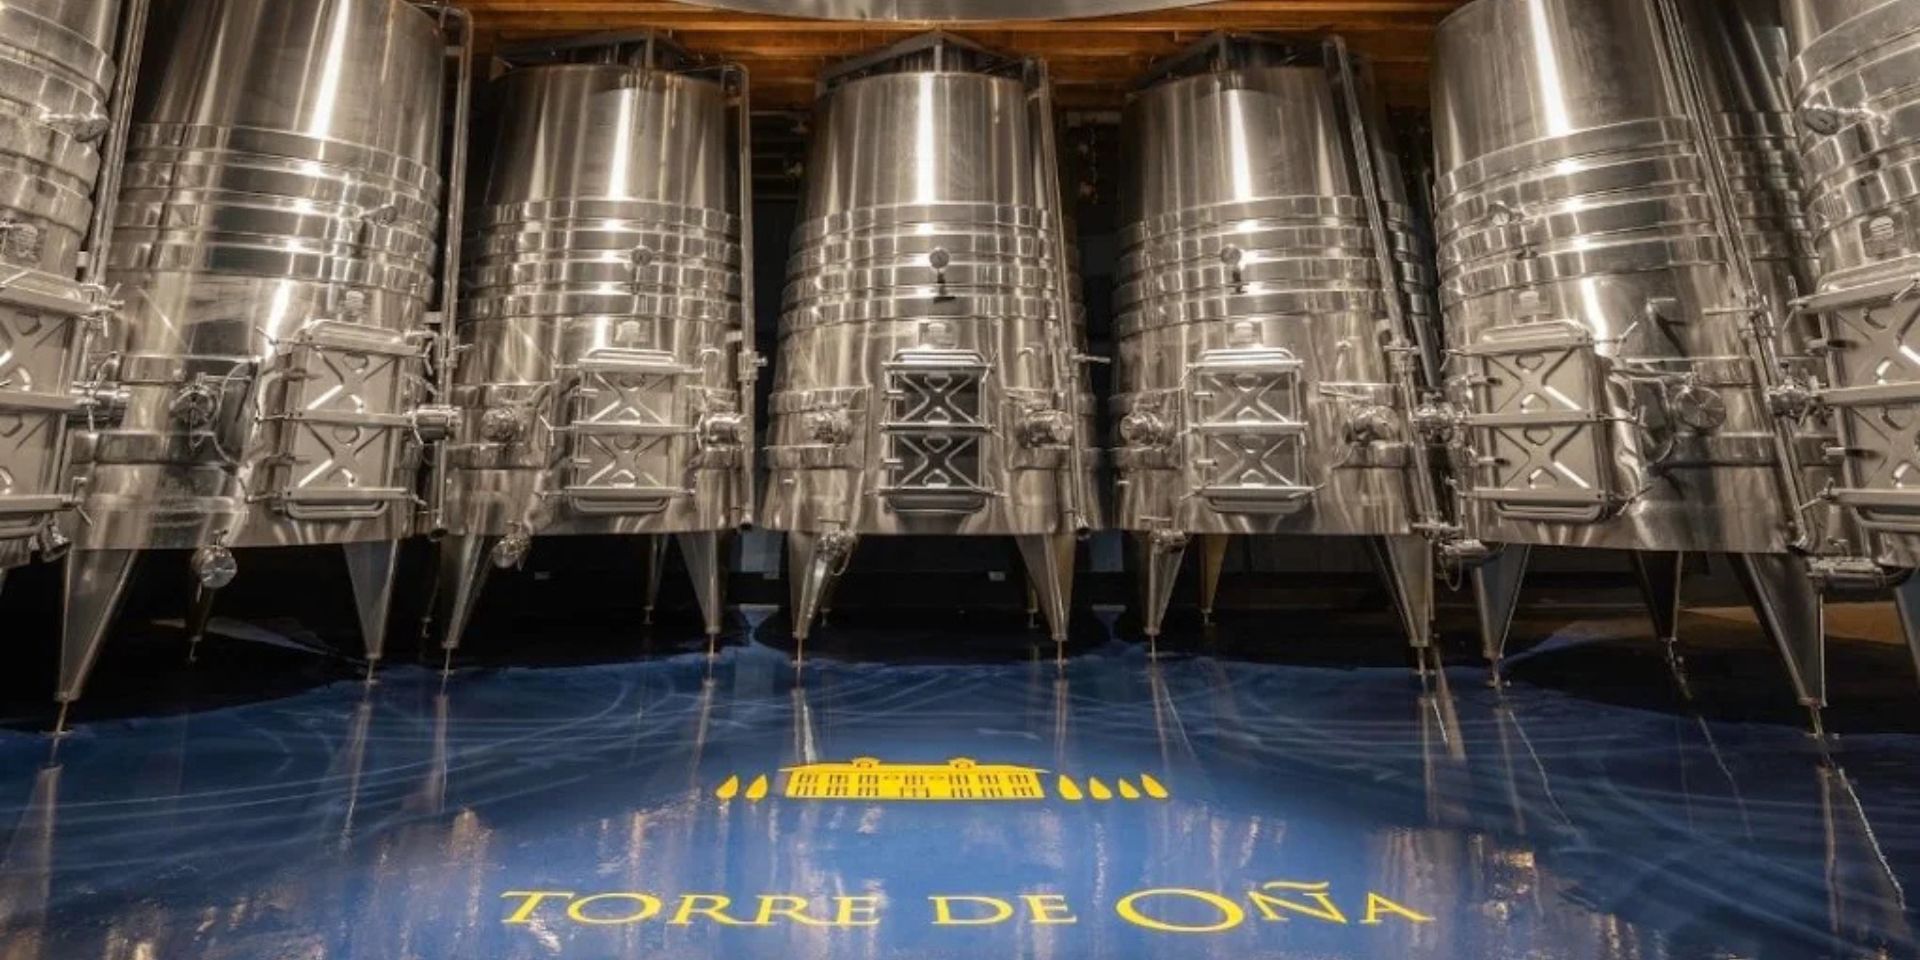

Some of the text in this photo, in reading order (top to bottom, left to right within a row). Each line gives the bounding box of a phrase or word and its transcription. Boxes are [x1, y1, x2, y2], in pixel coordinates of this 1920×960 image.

[500, 880, 1433, 933] TORRE DE OÑA
